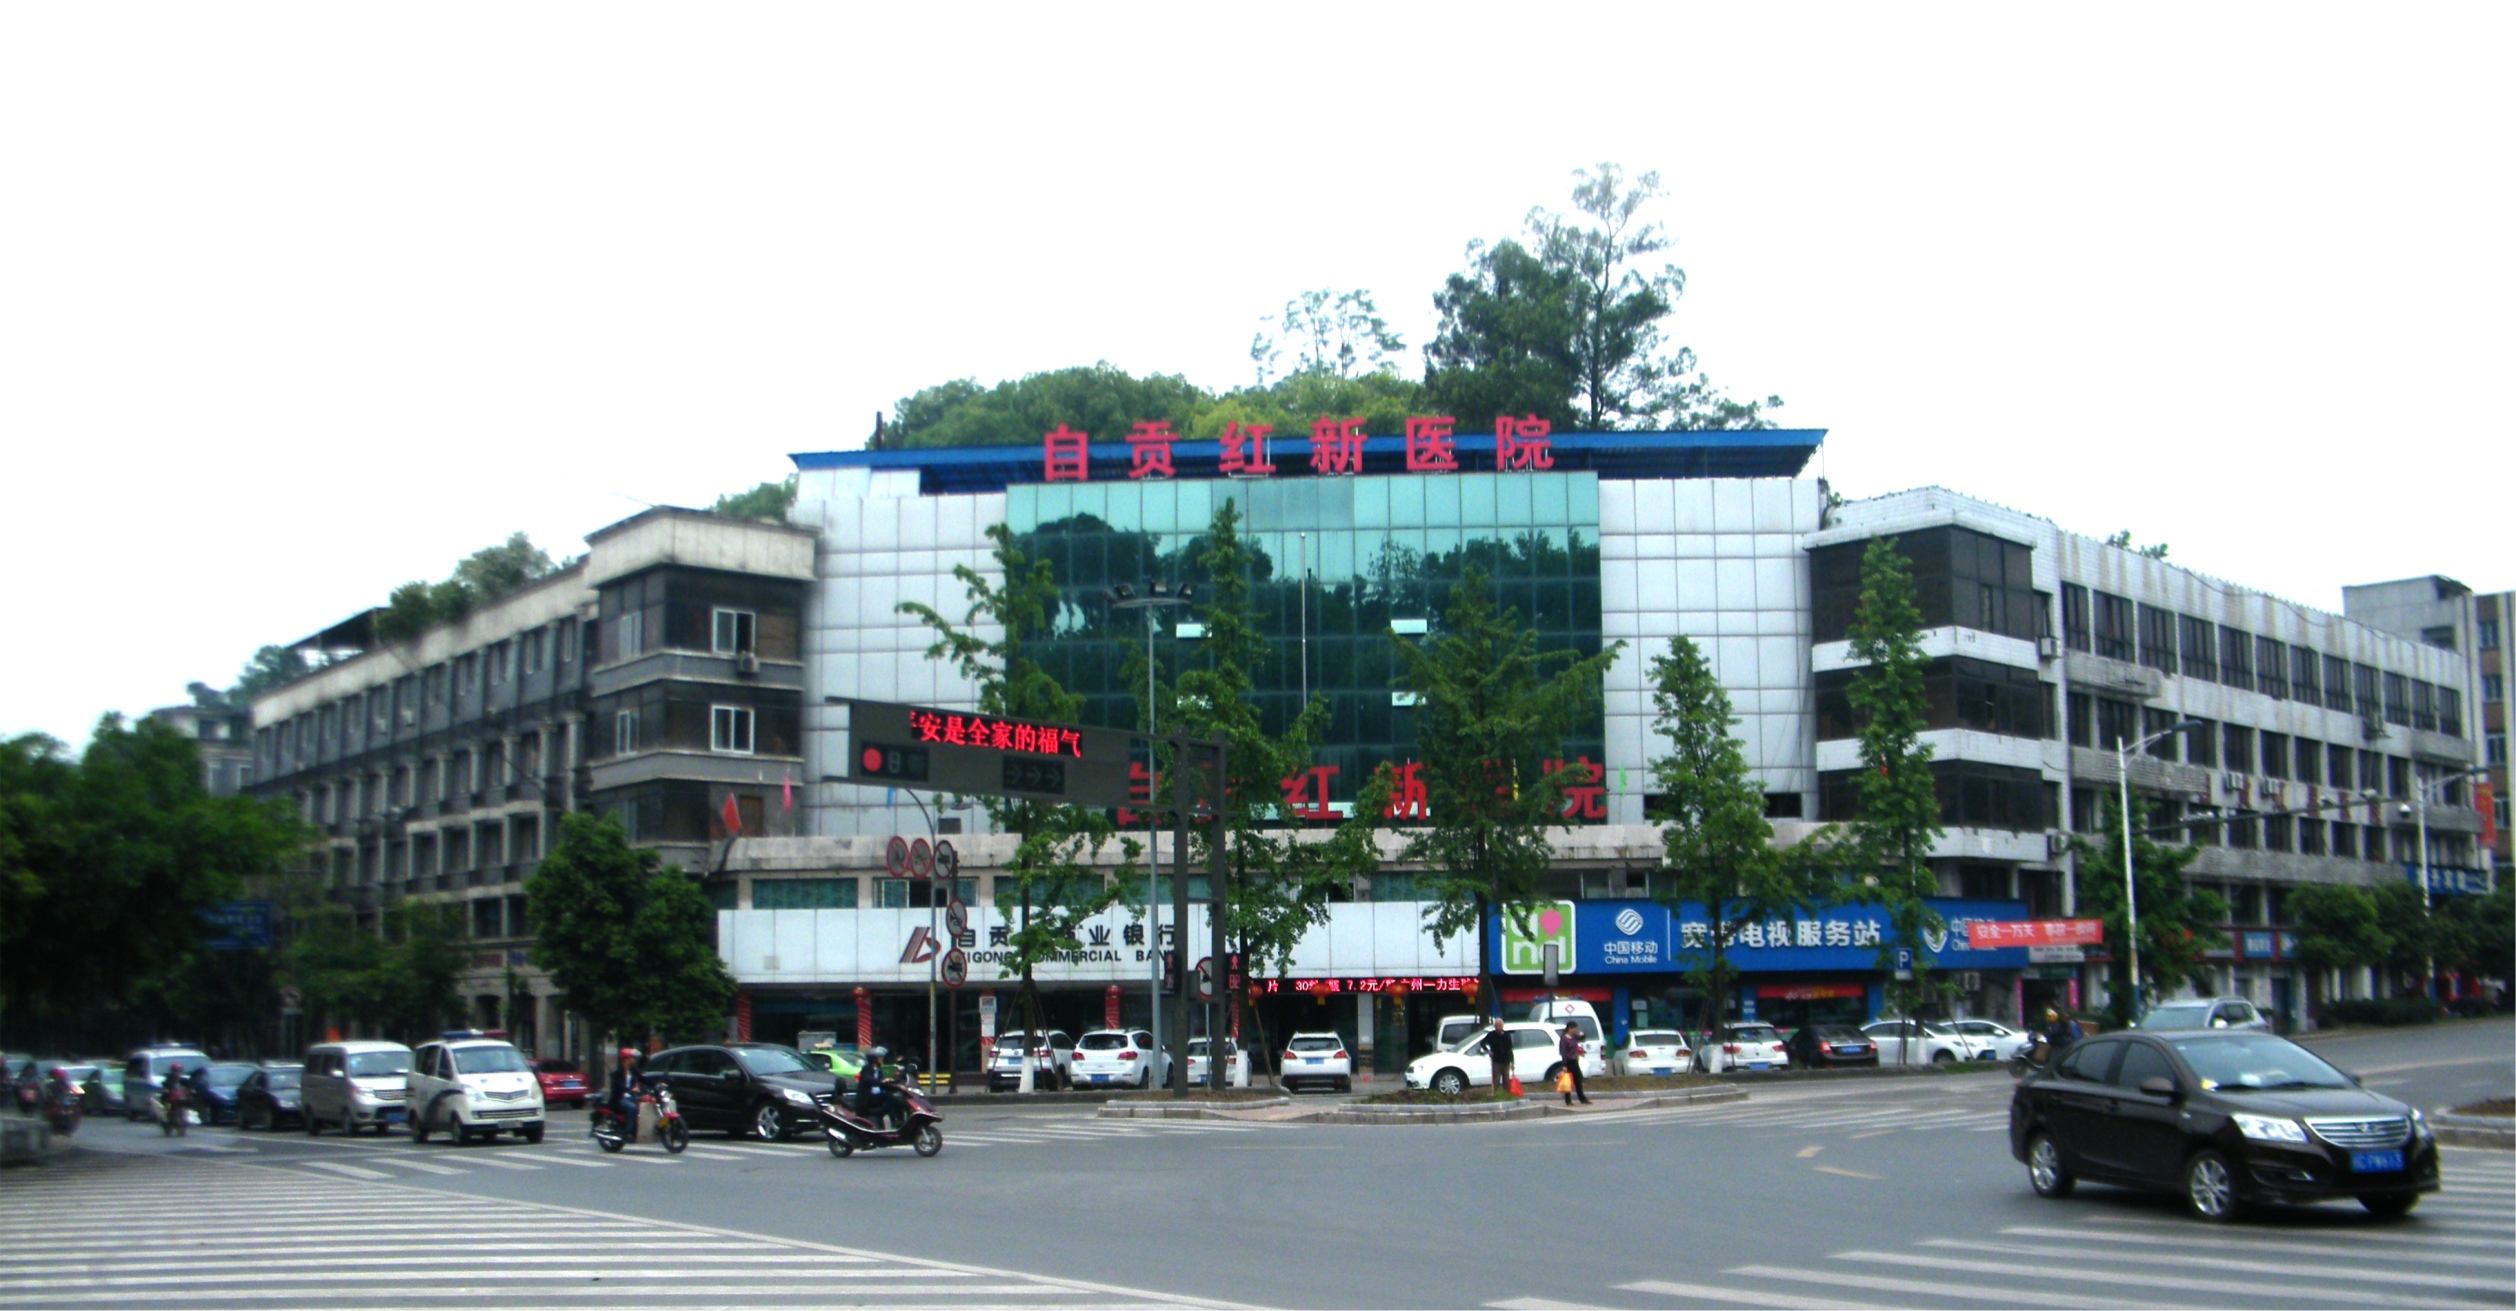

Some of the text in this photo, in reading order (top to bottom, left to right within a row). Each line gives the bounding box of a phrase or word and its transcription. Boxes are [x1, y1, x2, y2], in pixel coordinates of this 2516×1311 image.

[1044, 413, 1555, 482] 自贡红新医院
[957, 921, 1176, 947] 自贡业银行
[1604, 941, 1658, 955] 中国移动
[1604, 954, 1658, 964] China Mobile
[1899, 951, 1909, 968] P
[1267, 980, 1279, 993] 片
